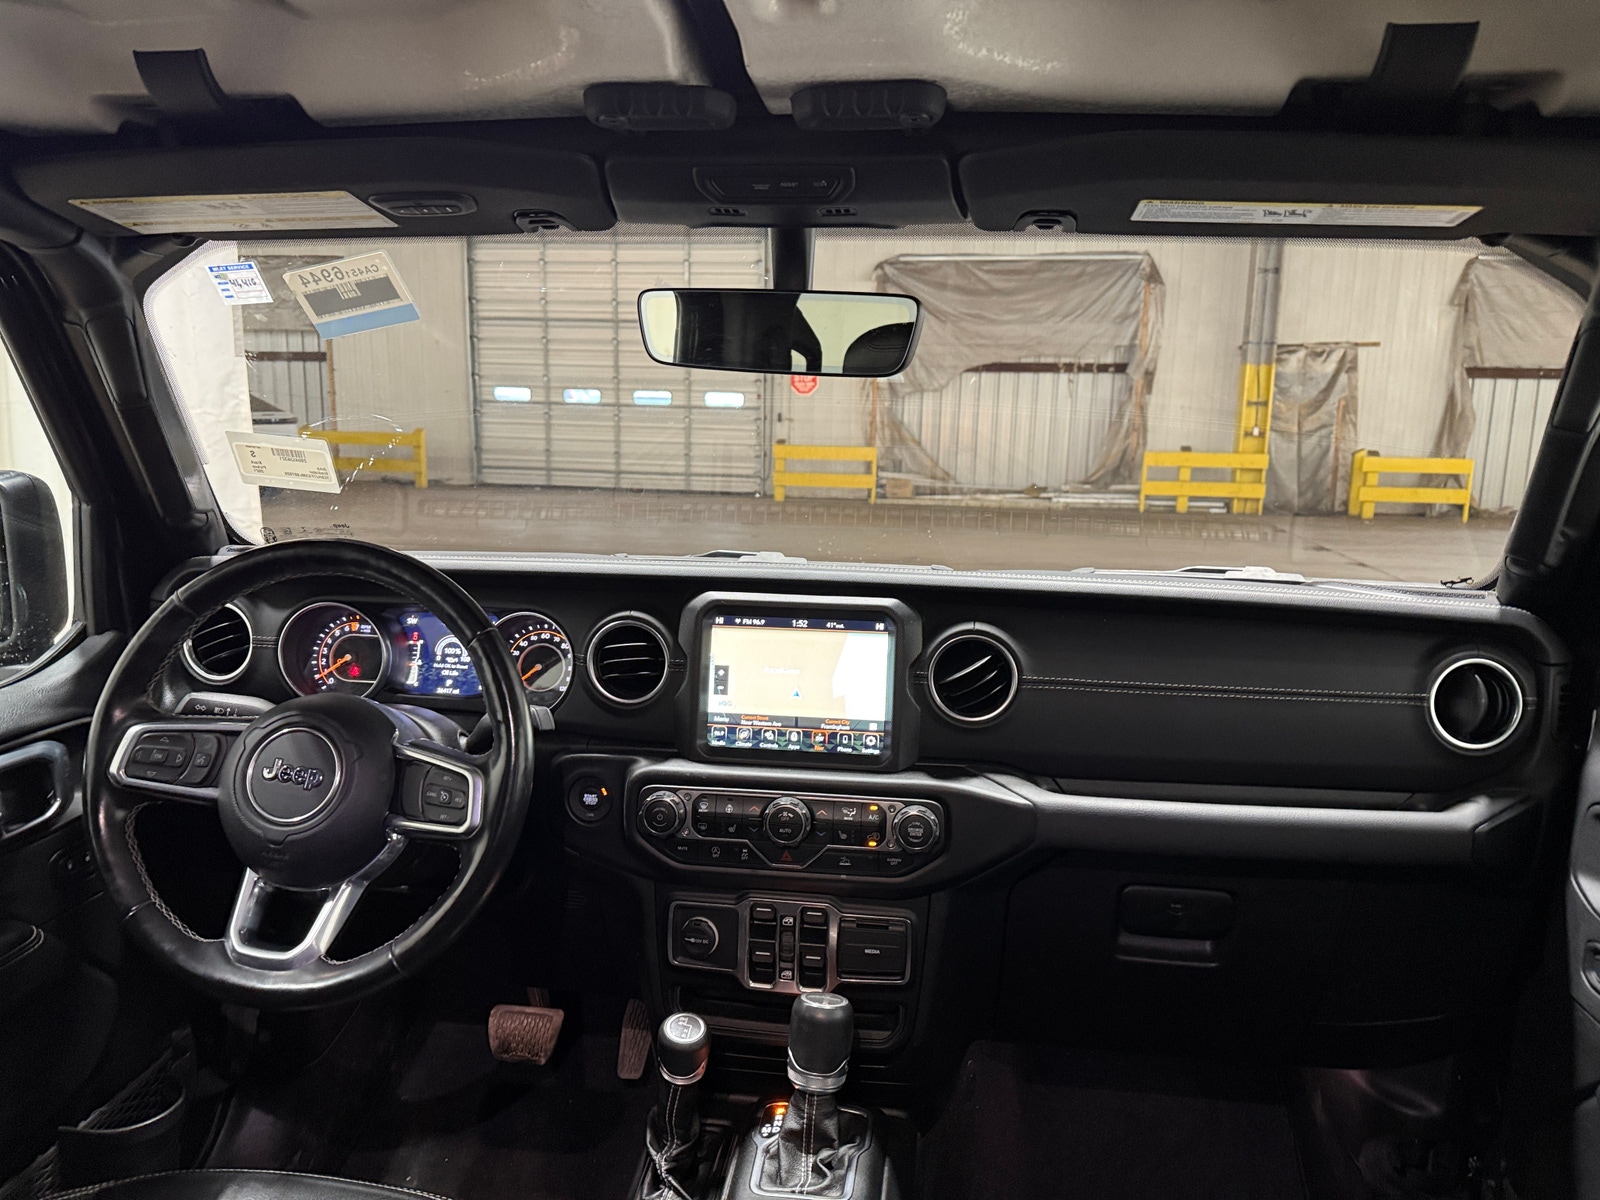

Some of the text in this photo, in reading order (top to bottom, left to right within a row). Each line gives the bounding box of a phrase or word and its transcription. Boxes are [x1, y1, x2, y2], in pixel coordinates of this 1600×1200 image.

[791, 619, 808, 628] 1:52
[334, 629, 341, 637] 5
[443, 647, 461, 655] 100%
[445, 679, 453, 687] P
[713, 715, 730, 723] Menu
[820, 723, 850, 731] Framingham
[787, 743, 800, 751] Apps
[861, 747, 881, 755] Settings
[262, 758, 323, 790] Jeep
[771, 1126, 781, 1134] D
